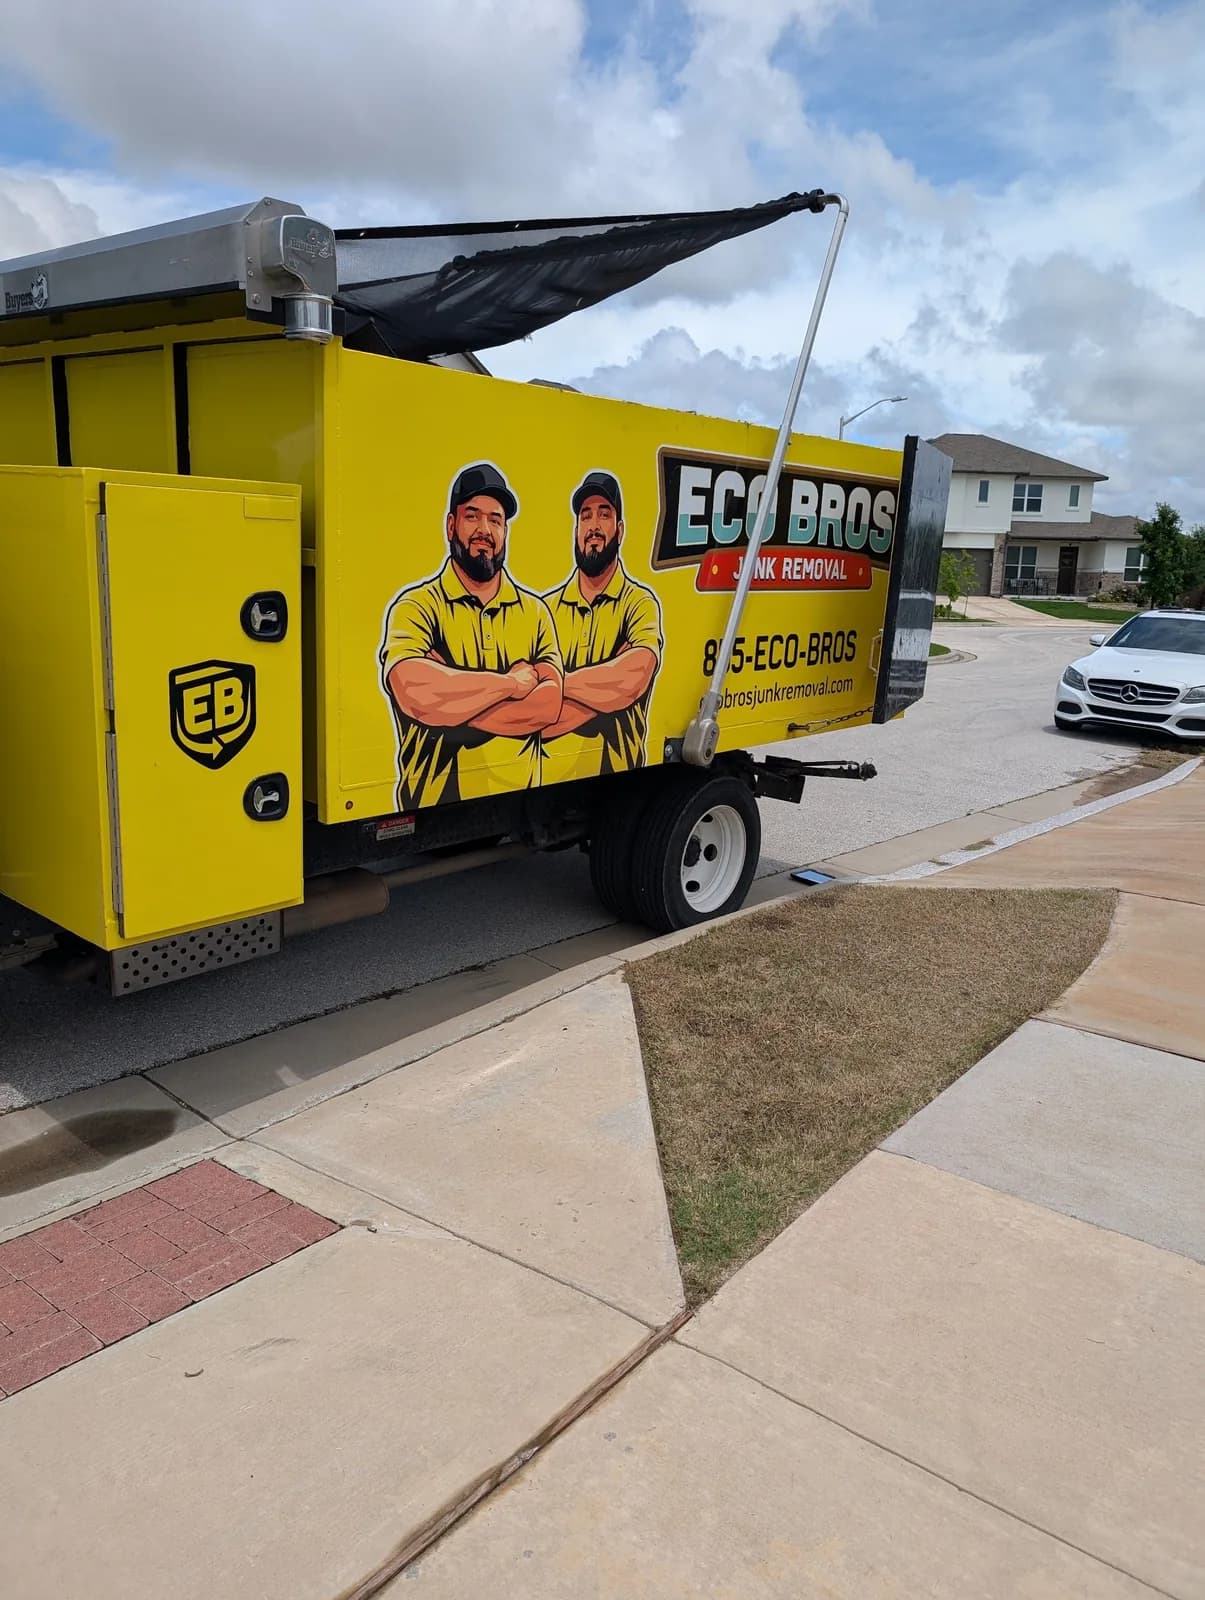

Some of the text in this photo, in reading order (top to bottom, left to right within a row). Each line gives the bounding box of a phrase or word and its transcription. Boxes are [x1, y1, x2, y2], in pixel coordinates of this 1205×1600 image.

[676, 465, 896, 553] ECO BROS
[732, 556, 848, 581] JNK REMOVAL
[183, 676, 244, 735] EB
